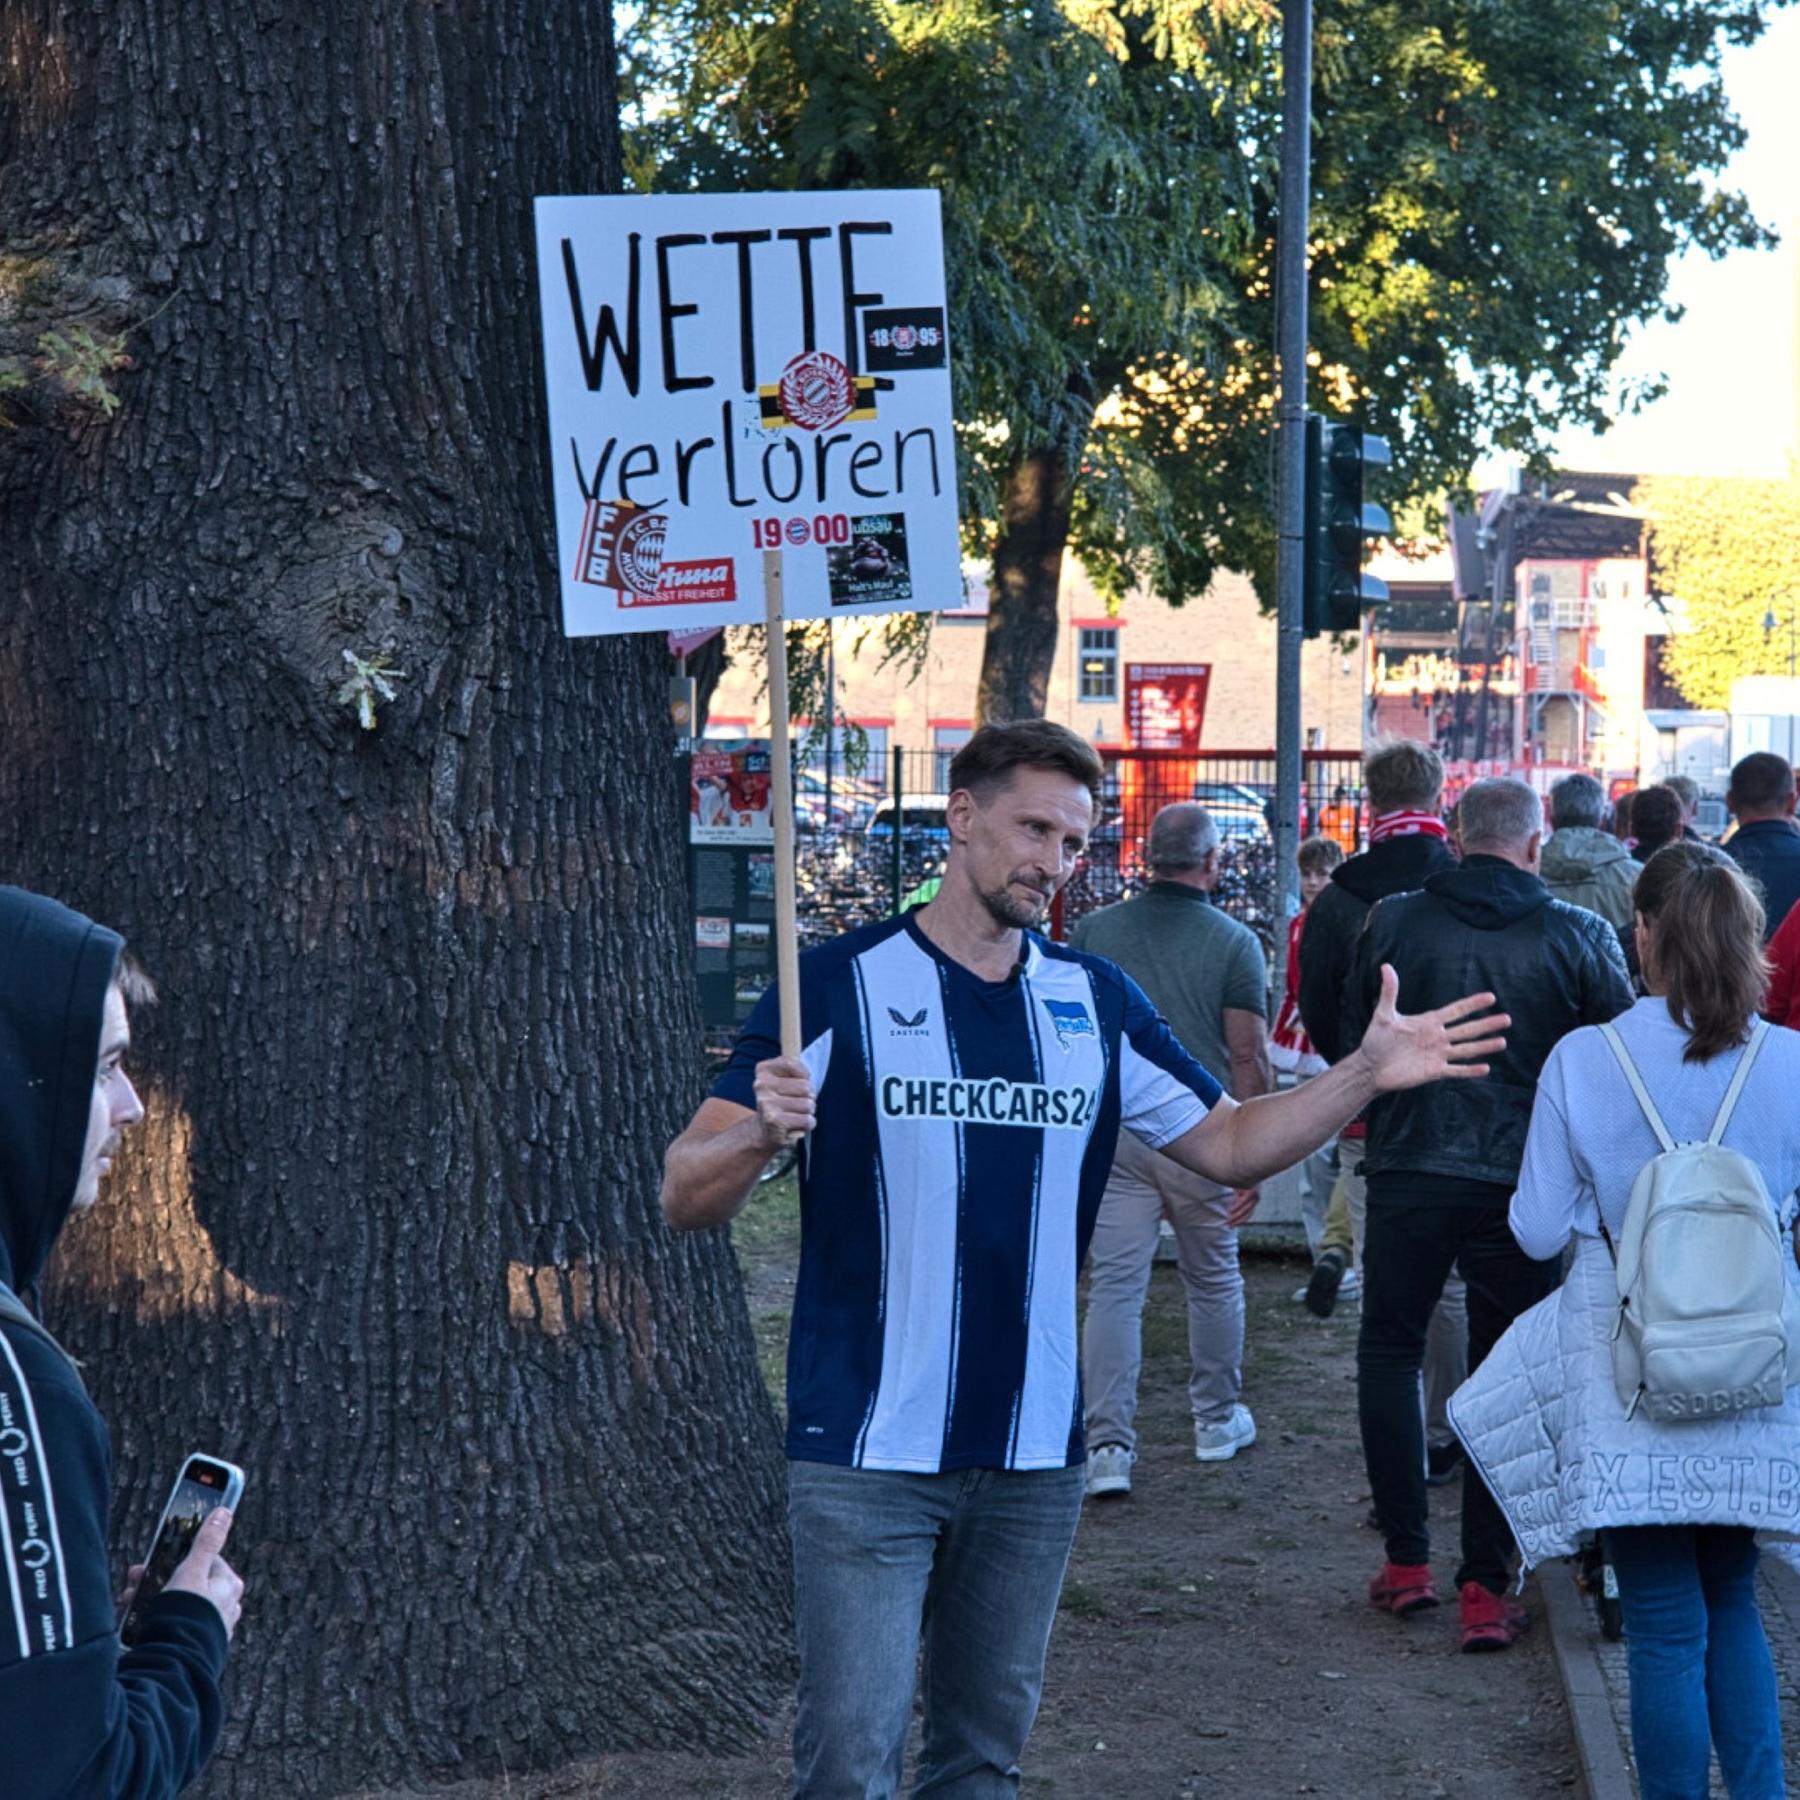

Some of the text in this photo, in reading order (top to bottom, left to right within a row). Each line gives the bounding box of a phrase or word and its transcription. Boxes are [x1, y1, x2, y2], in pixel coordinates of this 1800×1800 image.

[561, 222, 895, 398] WETTE
[570, 400, 941, 508] verloren
[657, 565, 729, 589] rtuna
